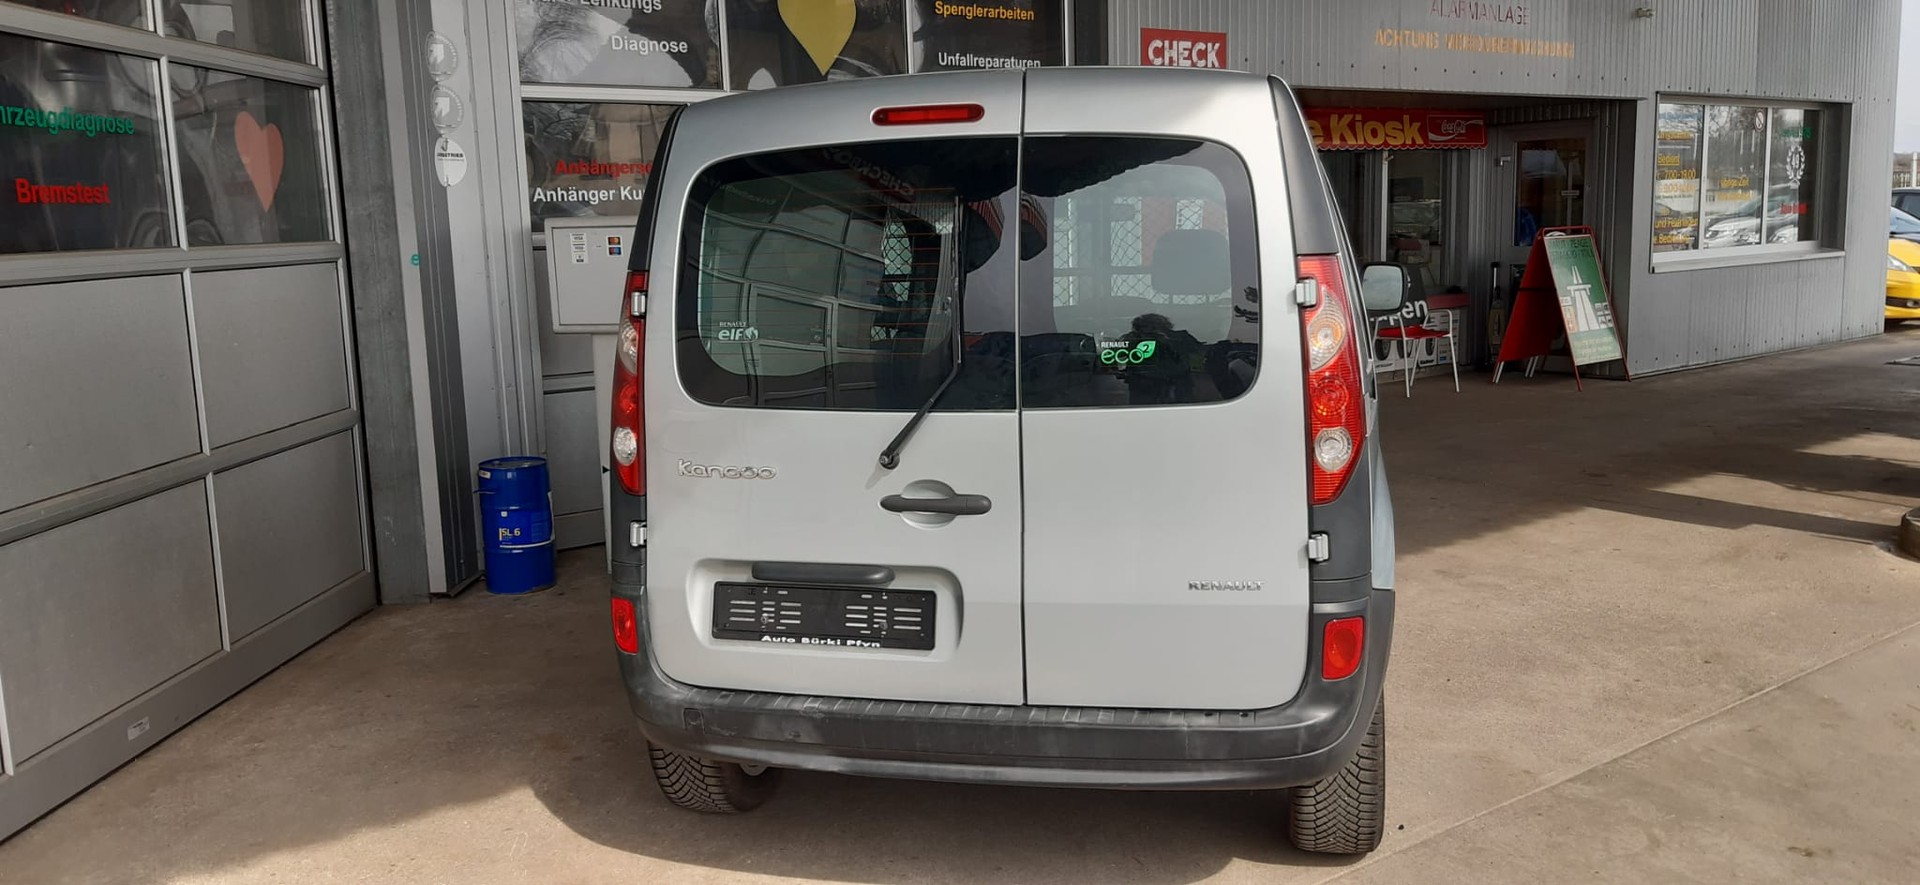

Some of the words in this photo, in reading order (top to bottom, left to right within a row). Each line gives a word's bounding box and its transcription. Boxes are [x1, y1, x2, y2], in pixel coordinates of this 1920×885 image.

[935, 1, 1034, 21] Spenglerarbeiten
[611, 36, 688, 54] Diagnose
[1148, 39, 1220, 68] CHECK
[938, 52, 1041, 69] Unfallreparaturen
[1330, 114, 1424, 145] Kiosk
[15, 177, 111, 204] Bremstest
[533, 186, 615, 205] Anhänger
[620, 185, 645, 201] Ku
[719, 328, 744, 340] elf
[678, 459, 777, 480] Kangoo
[1187, 579, 1265, 592] RENAULT
[761, 635, 796, 644] Auto
[801, 637, 841, 646] Bürki
[846, 639, 881, 648] Pfyn
